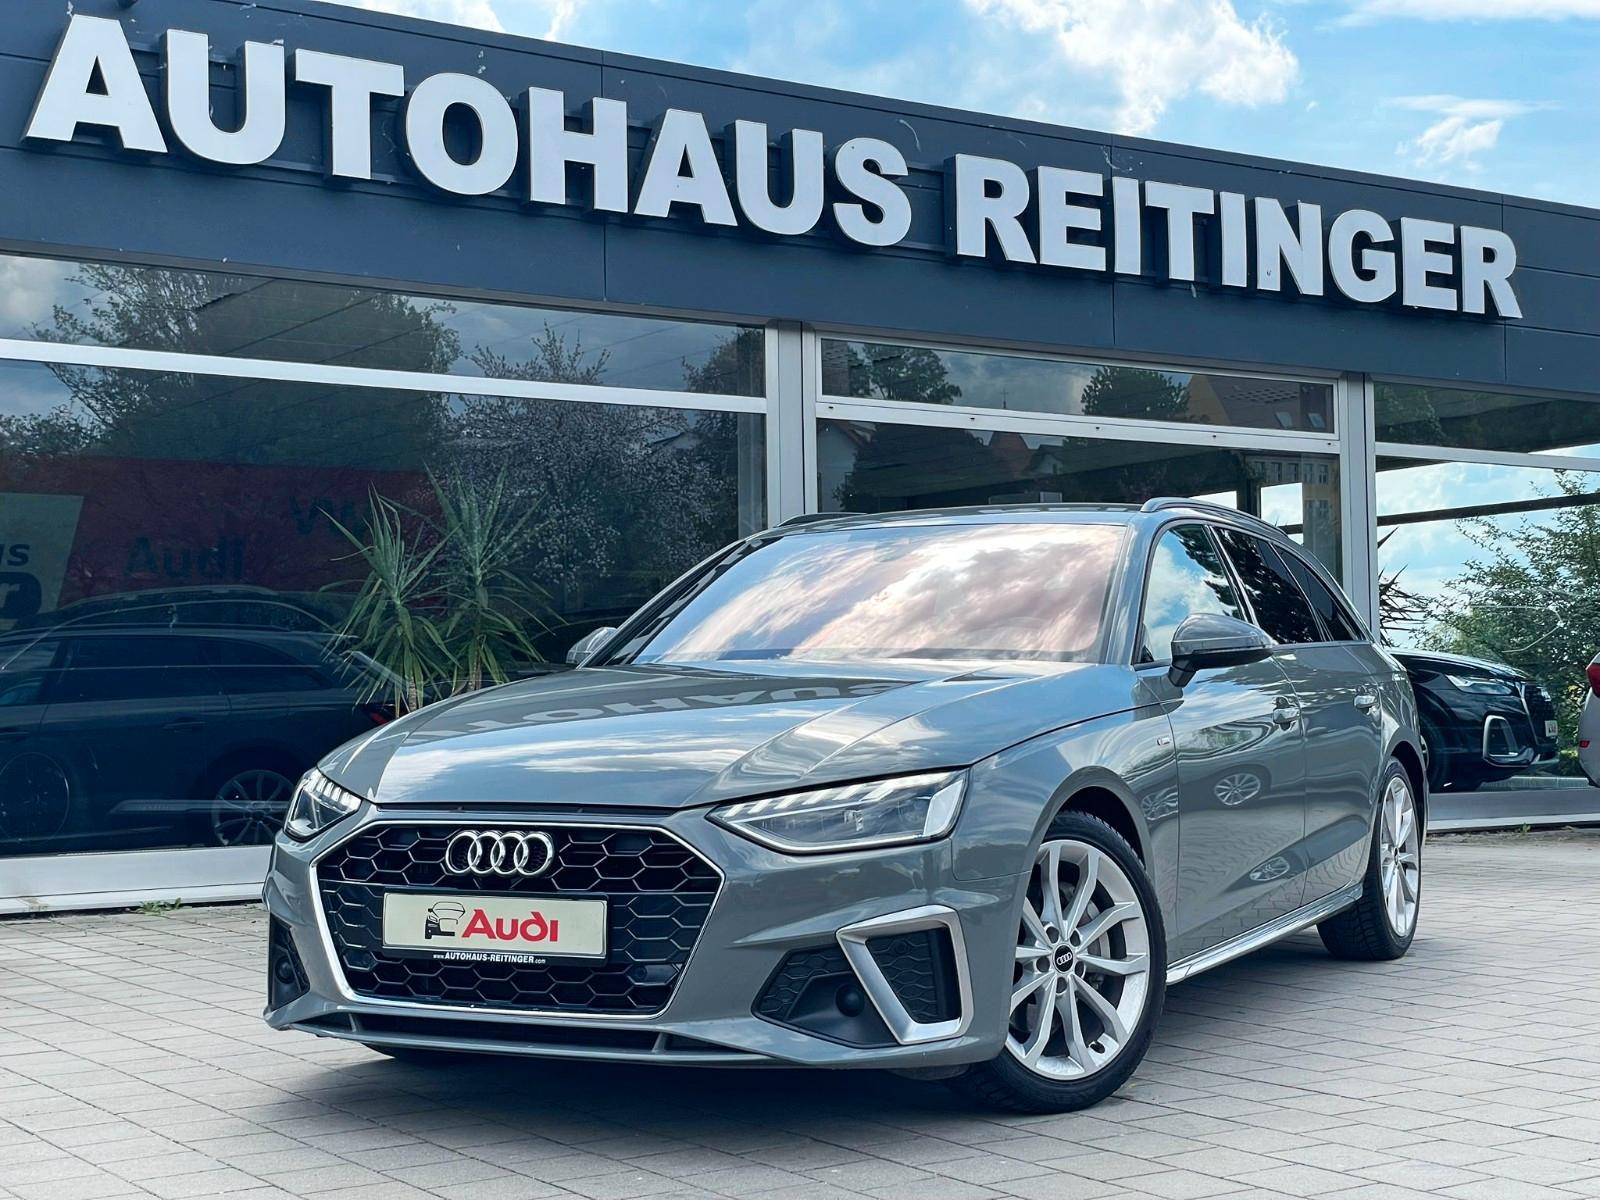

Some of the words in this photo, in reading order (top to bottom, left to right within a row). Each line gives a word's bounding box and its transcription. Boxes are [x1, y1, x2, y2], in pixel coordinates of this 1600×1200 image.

[24, 14, 912, 247] AUTOHAUS
[954, 153, 1524, 319] REITINGER
[126, 534, 243, 578] Audi
[461, 908, 559, 943] Audi
[432, 951, 547, 964] www.AUTOHAUS-REITINGER.com
